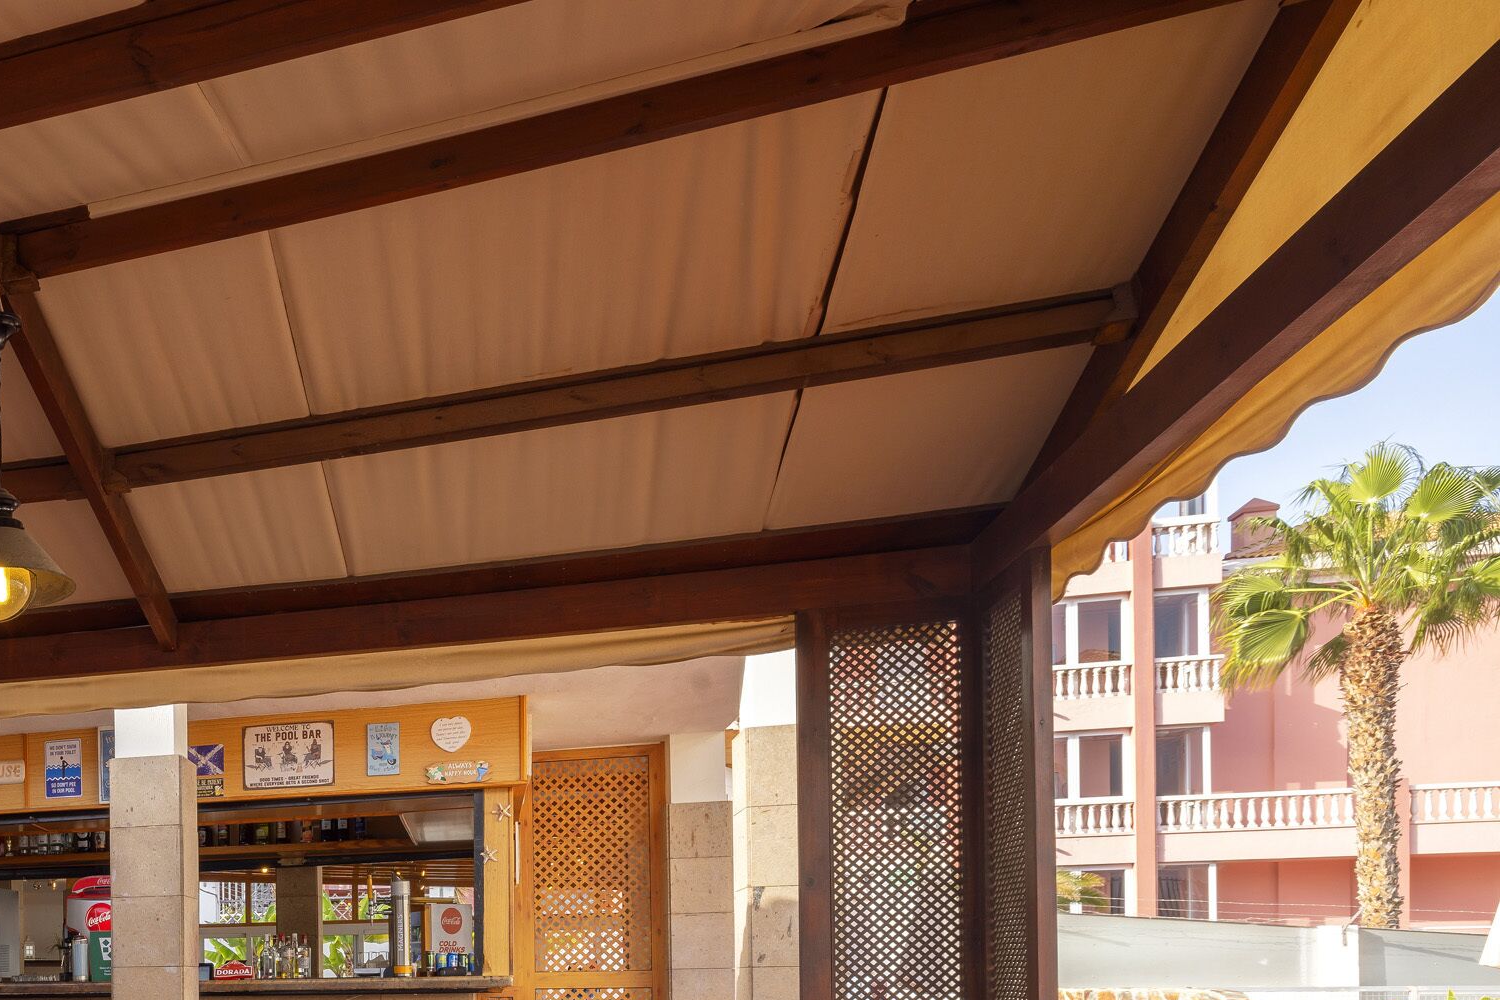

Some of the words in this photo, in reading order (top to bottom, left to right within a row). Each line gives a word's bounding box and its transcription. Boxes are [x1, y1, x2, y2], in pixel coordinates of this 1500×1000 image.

[266, 724, 299, 733] WELCOME
[254, 733, 272, 742] THE
[275, 731, 299, 741] POOL
[302, 729, 322, 739] BAR
[216, 968, 251, 976] DORADA
